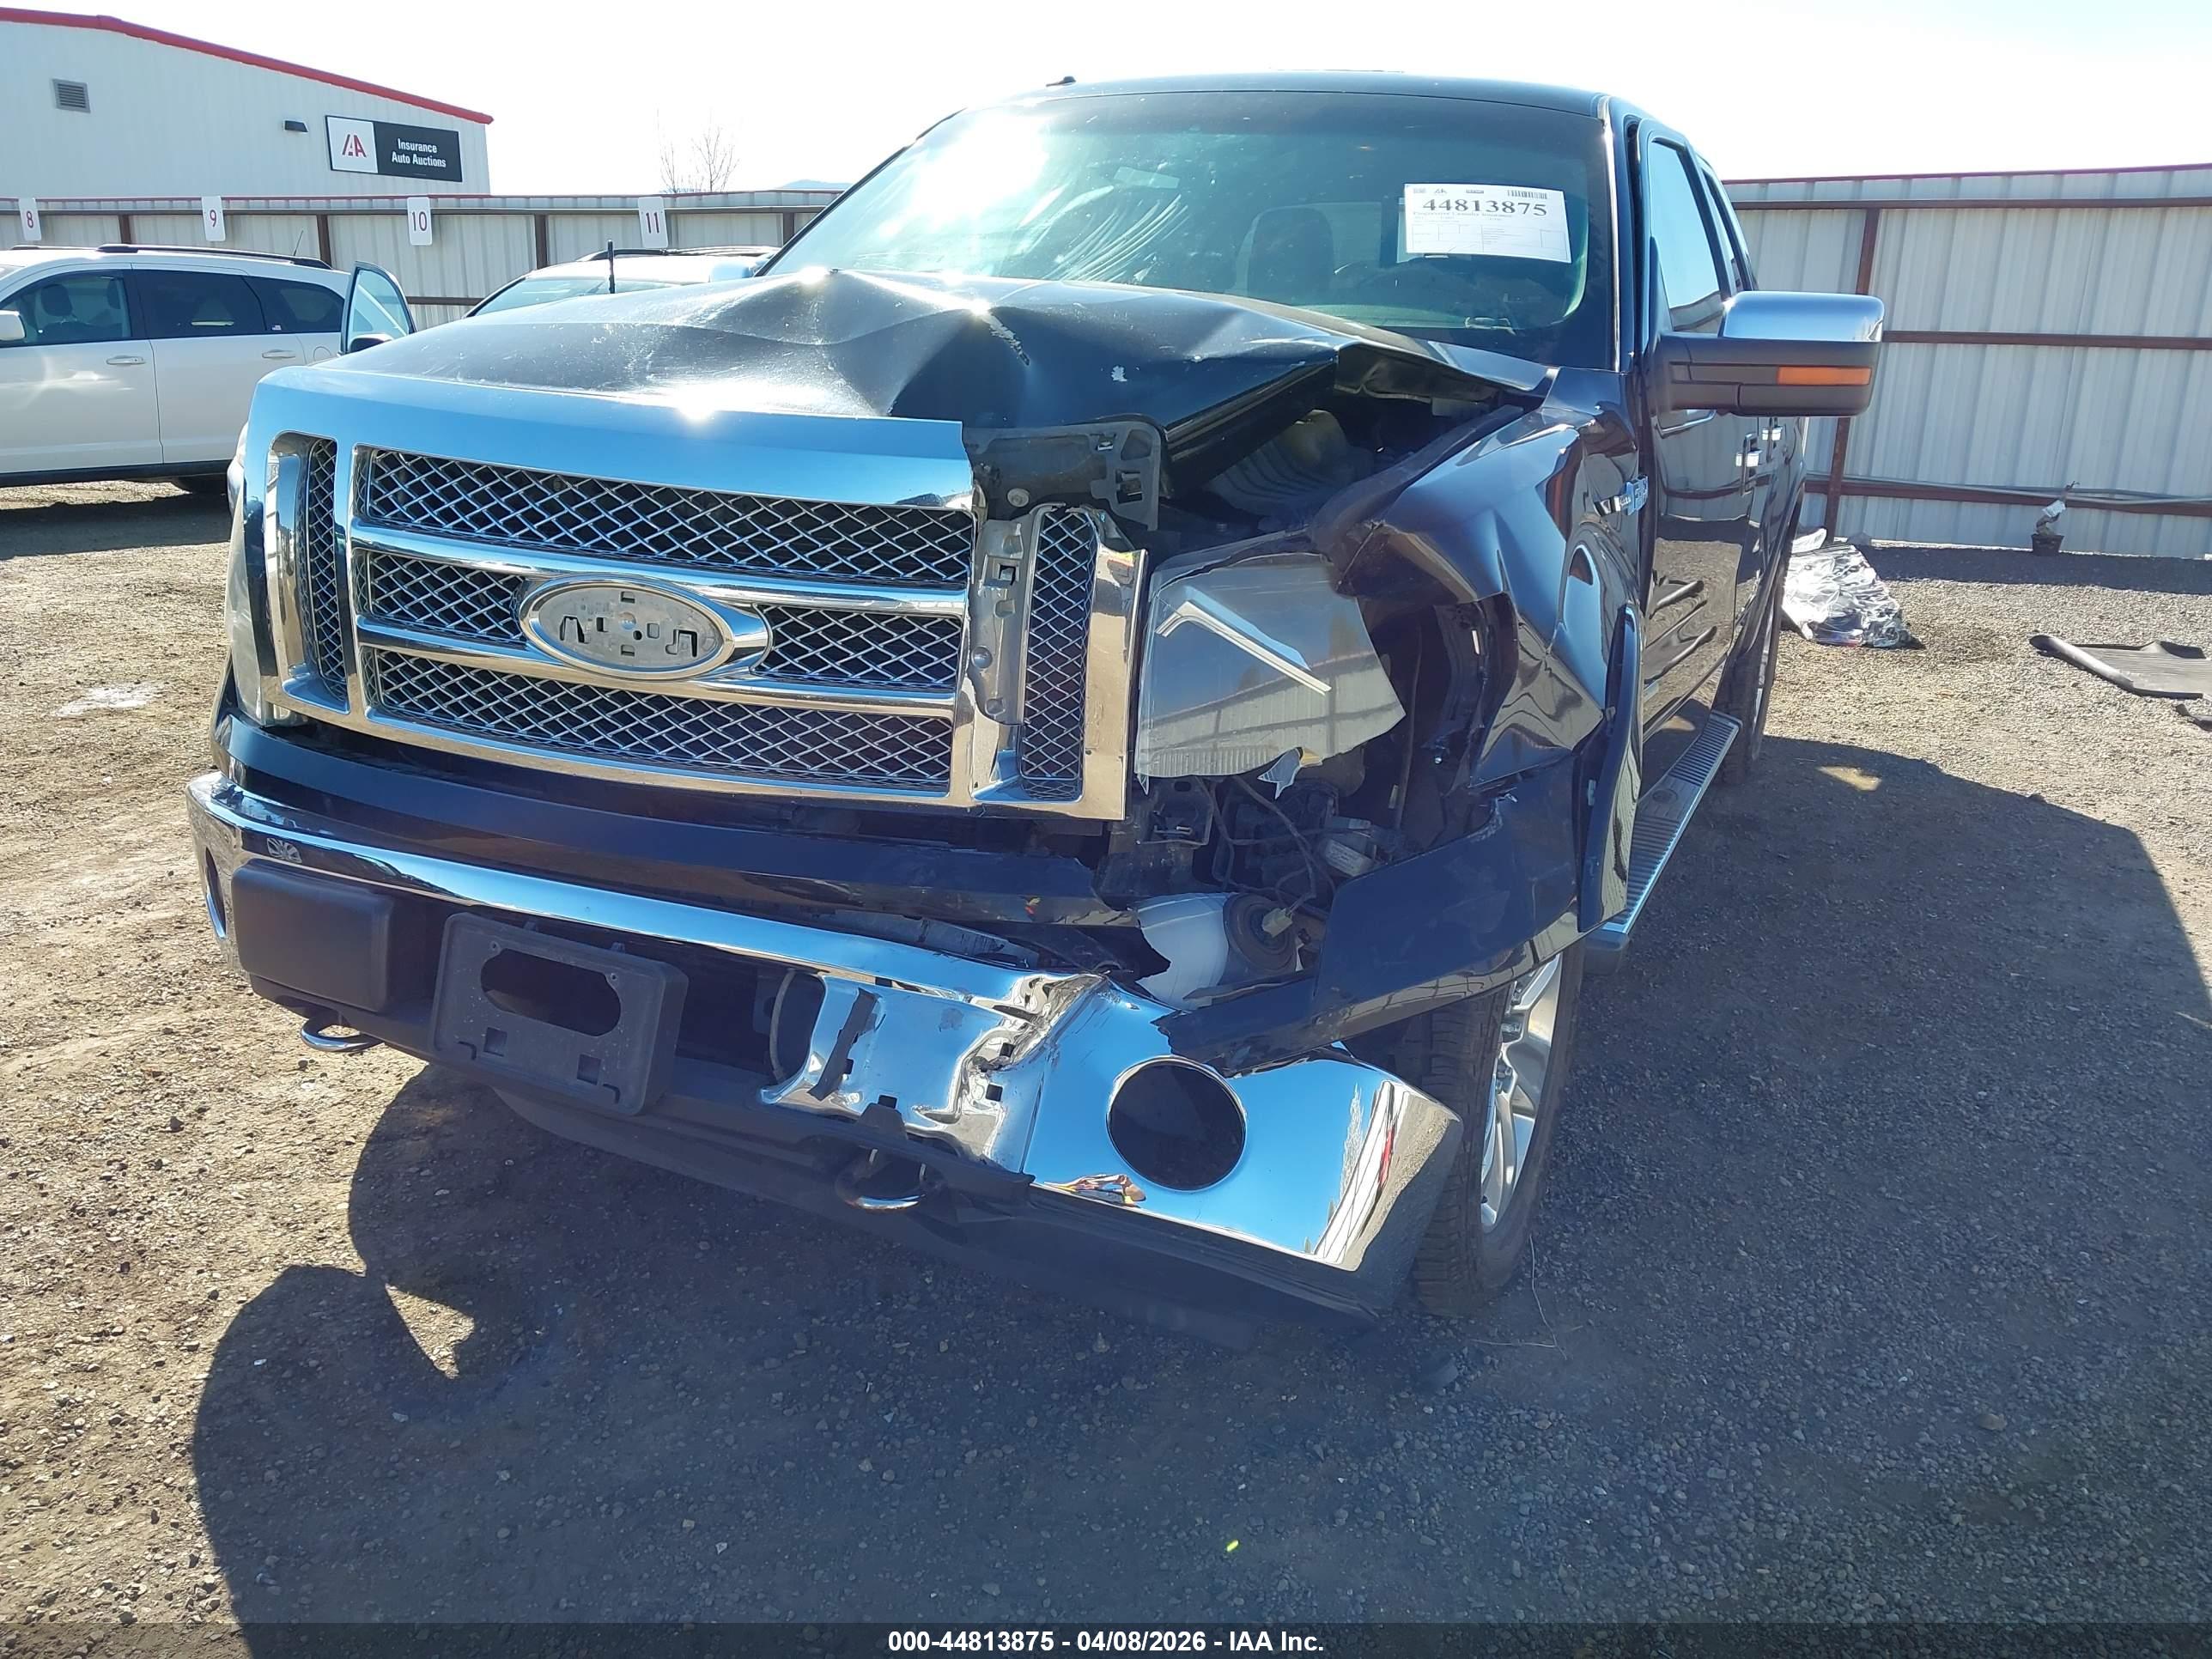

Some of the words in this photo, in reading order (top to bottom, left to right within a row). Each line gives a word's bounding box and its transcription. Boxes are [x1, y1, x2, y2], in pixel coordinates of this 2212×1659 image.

[398, 137, 438, 154] Insurance
[392, 151, 410, 165] Auto
[412, 155, 447, 168] Auctions
[1422, 198, 1547, 216] 44813875
[26, 210, 34, 228] 8
[209, 210, 217, 228] 9
[411, 211, 428, 232] 10
[644, 212, 660, 234] 11
